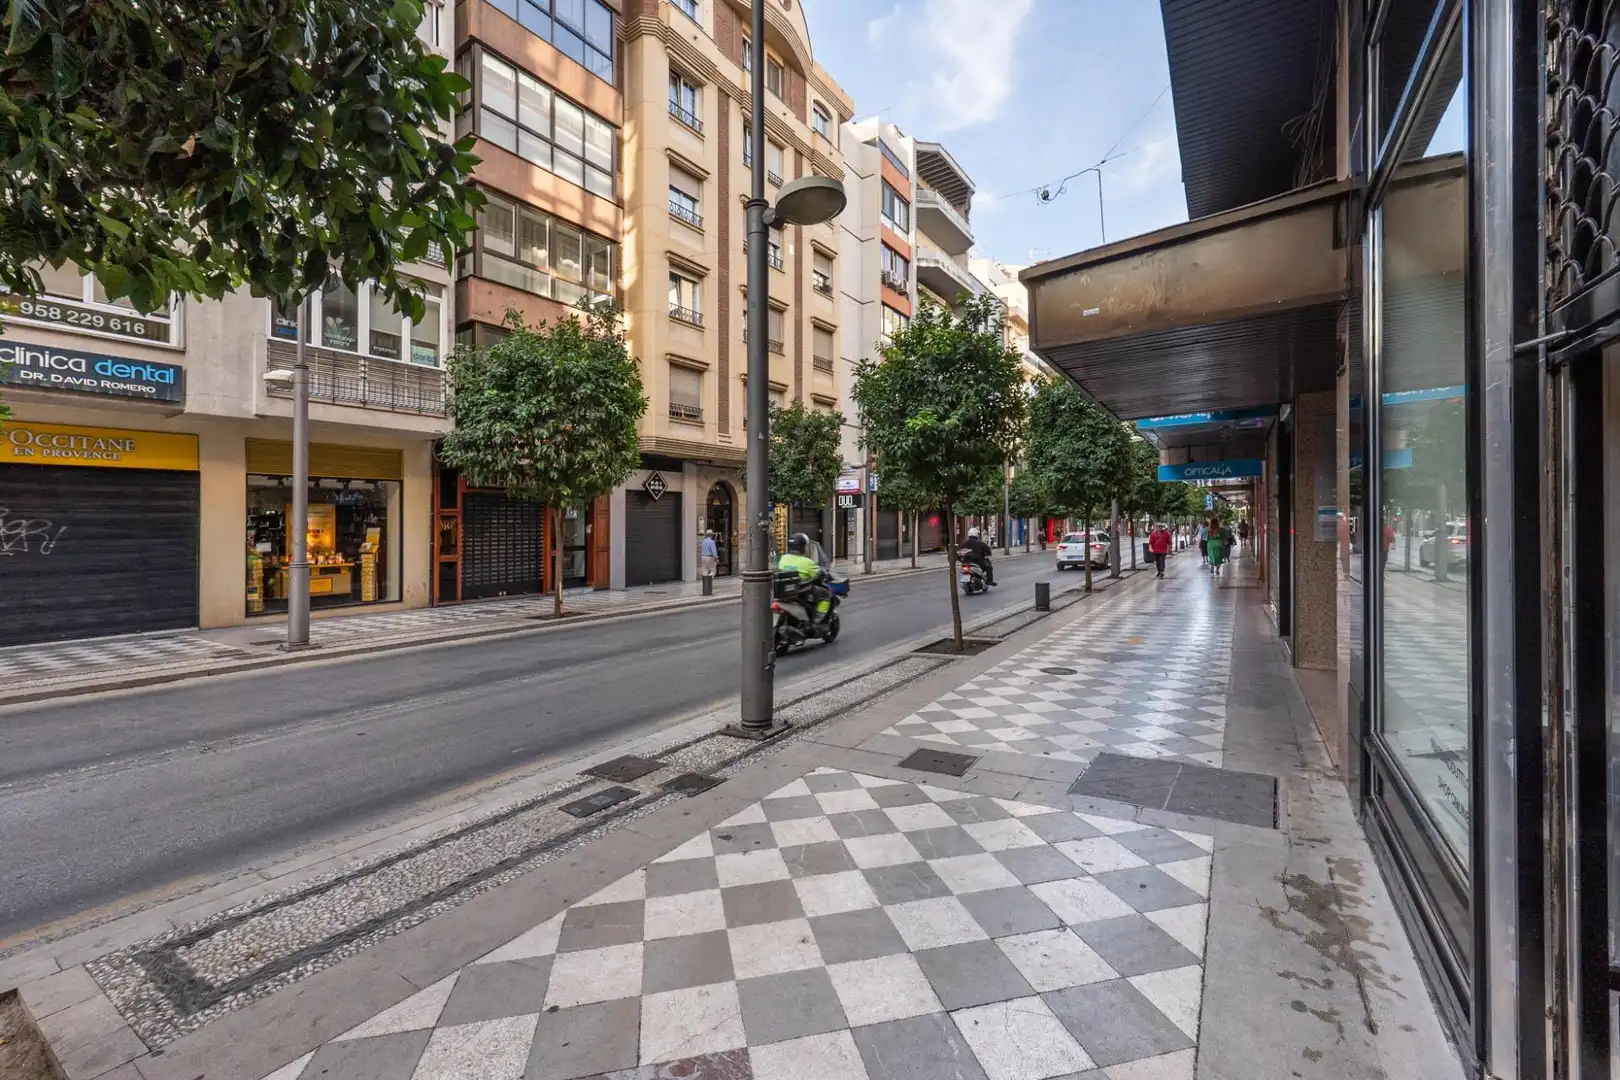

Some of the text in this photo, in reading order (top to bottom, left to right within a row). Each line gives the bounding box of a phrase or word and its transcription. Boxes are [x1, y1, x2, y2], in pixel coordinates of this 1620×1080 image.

[20, 301, 146, 335] 958 229 616
[20, 370, 156, 394] DR. DAVID ROMERO
[94, 359, 175, 385] dental
[0, 429, 137, 452] 'OCCITANE
[14, 447, 121, 460] EN PROVENCE
[838, 495, 853, 506] DUO
